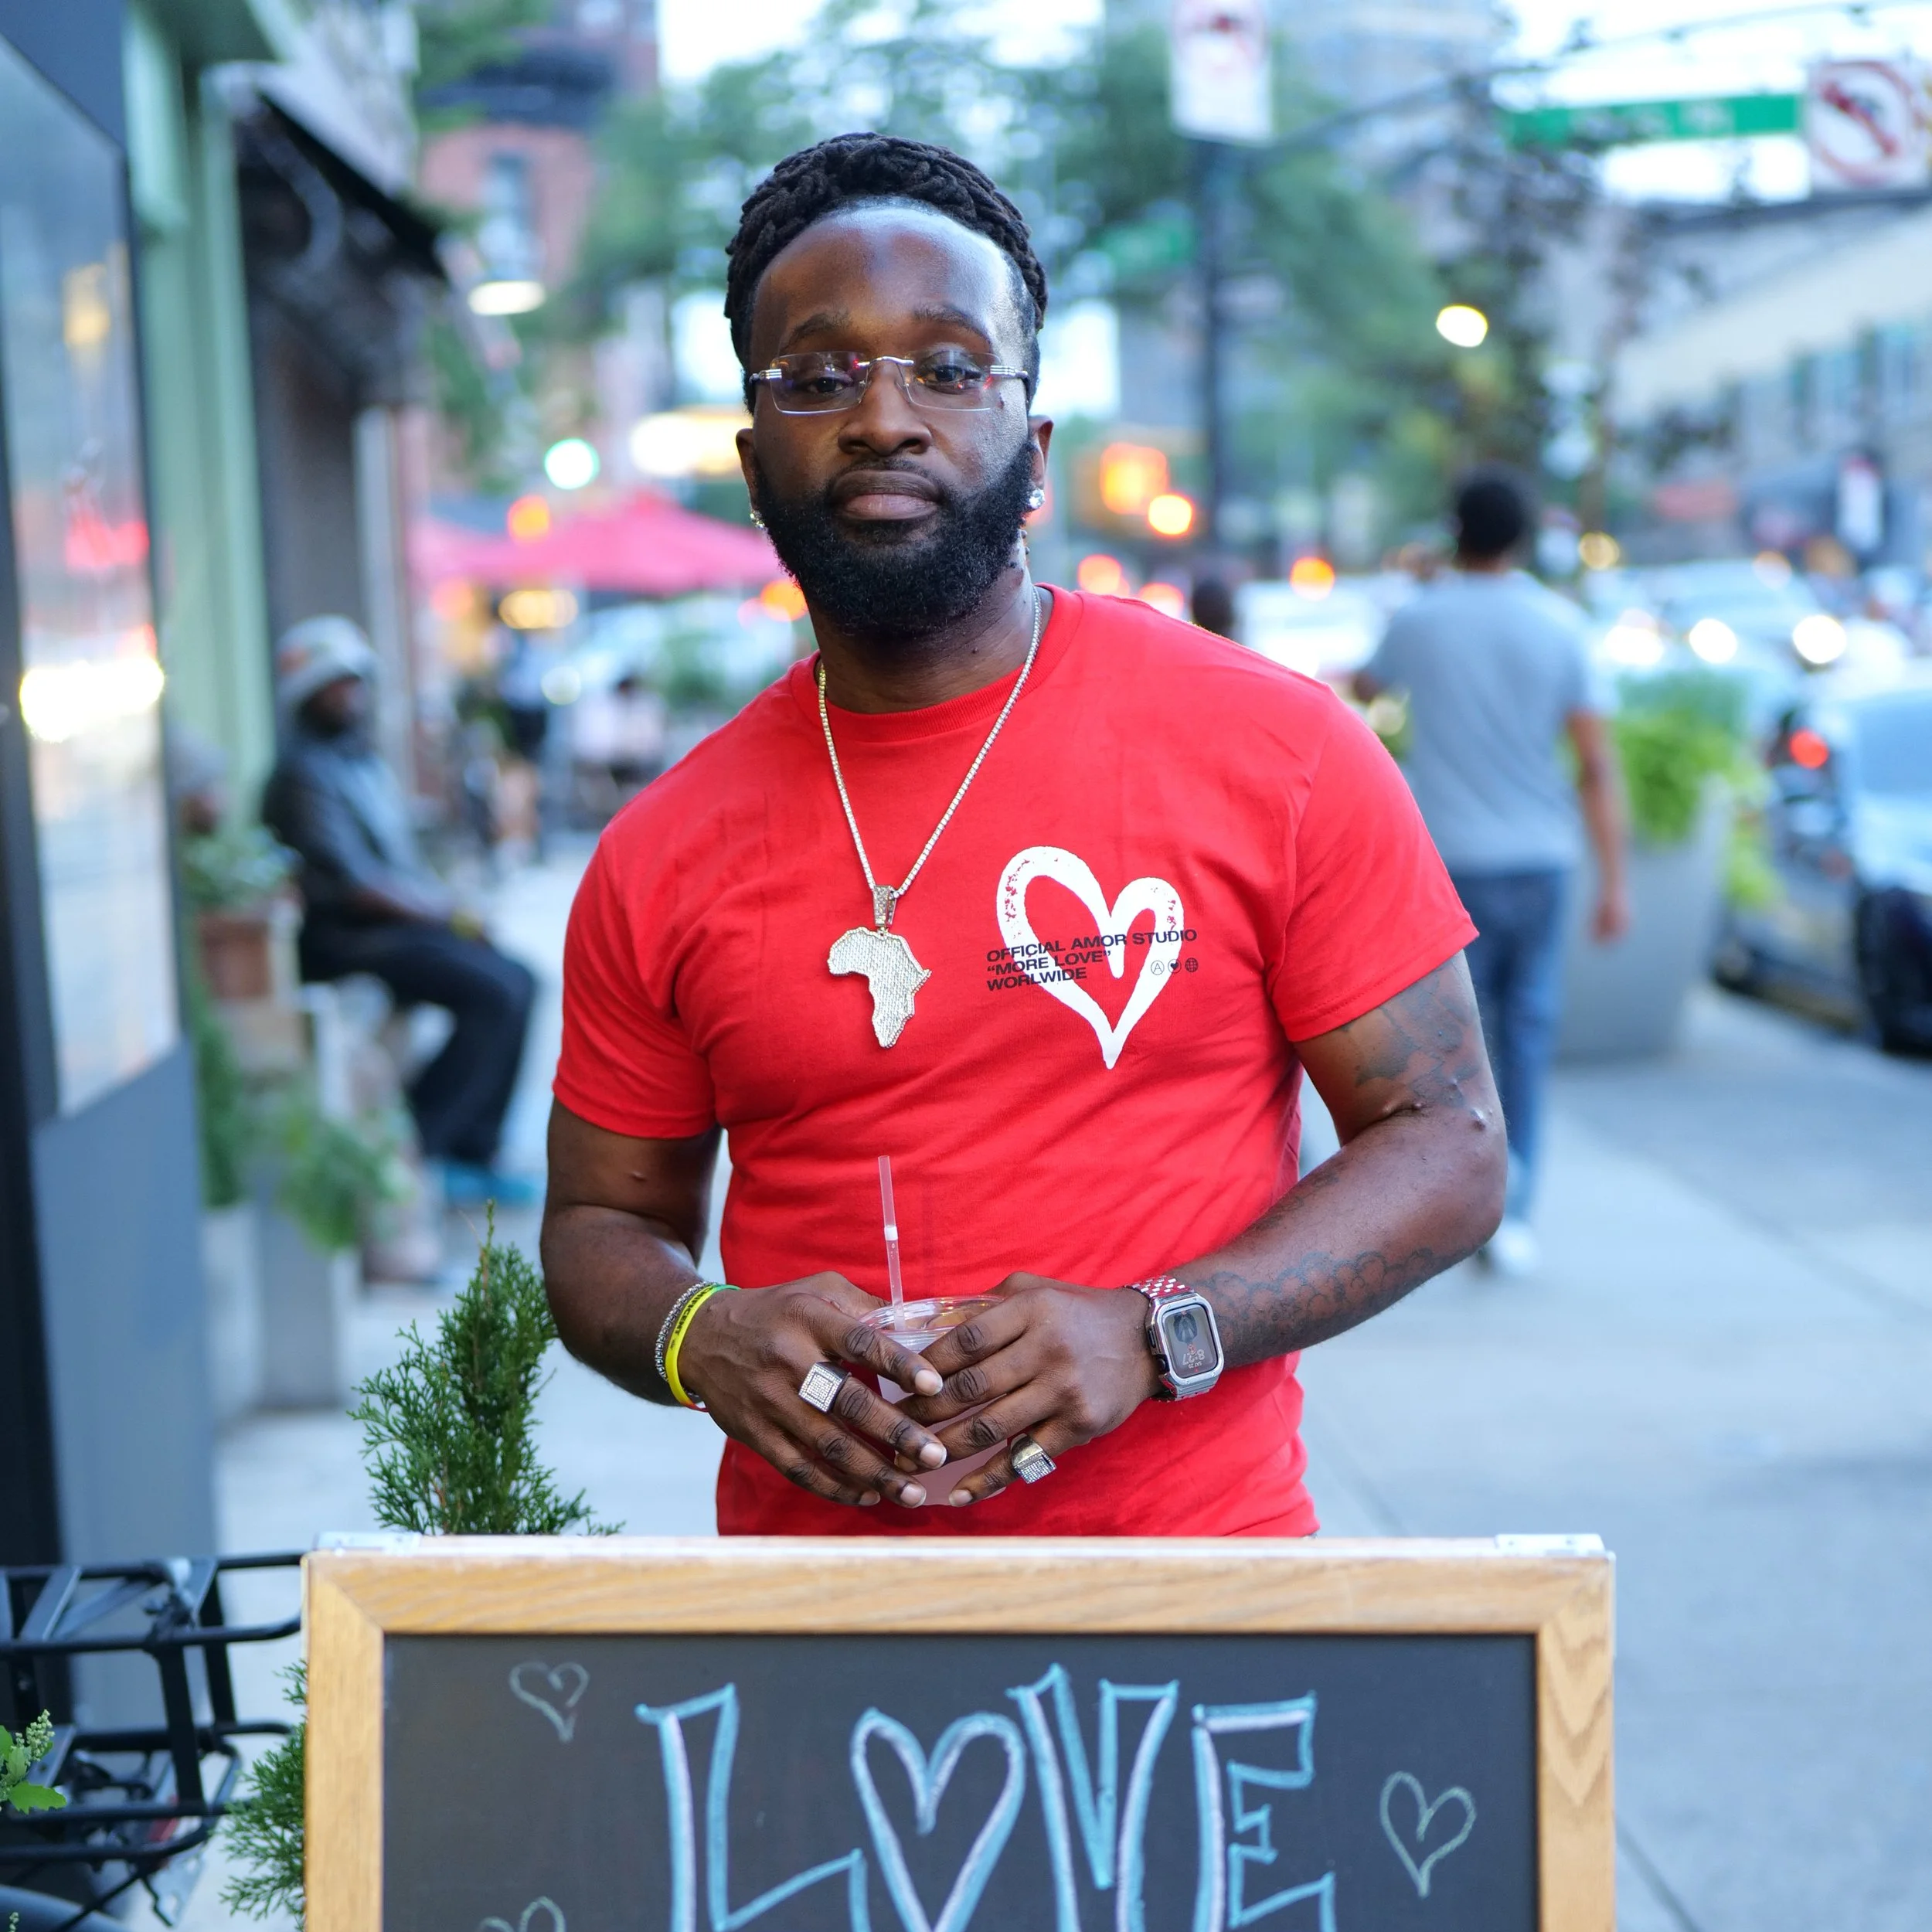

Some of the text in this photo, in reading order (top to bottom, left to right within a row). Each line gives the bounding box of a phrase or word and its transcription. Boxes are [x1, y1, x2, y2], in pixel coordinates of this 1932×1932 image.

[986, 929, 1198, 962] OFFICIAL AMOR STUDIO
[986, 967, 1087, 992] WORLWIDE
